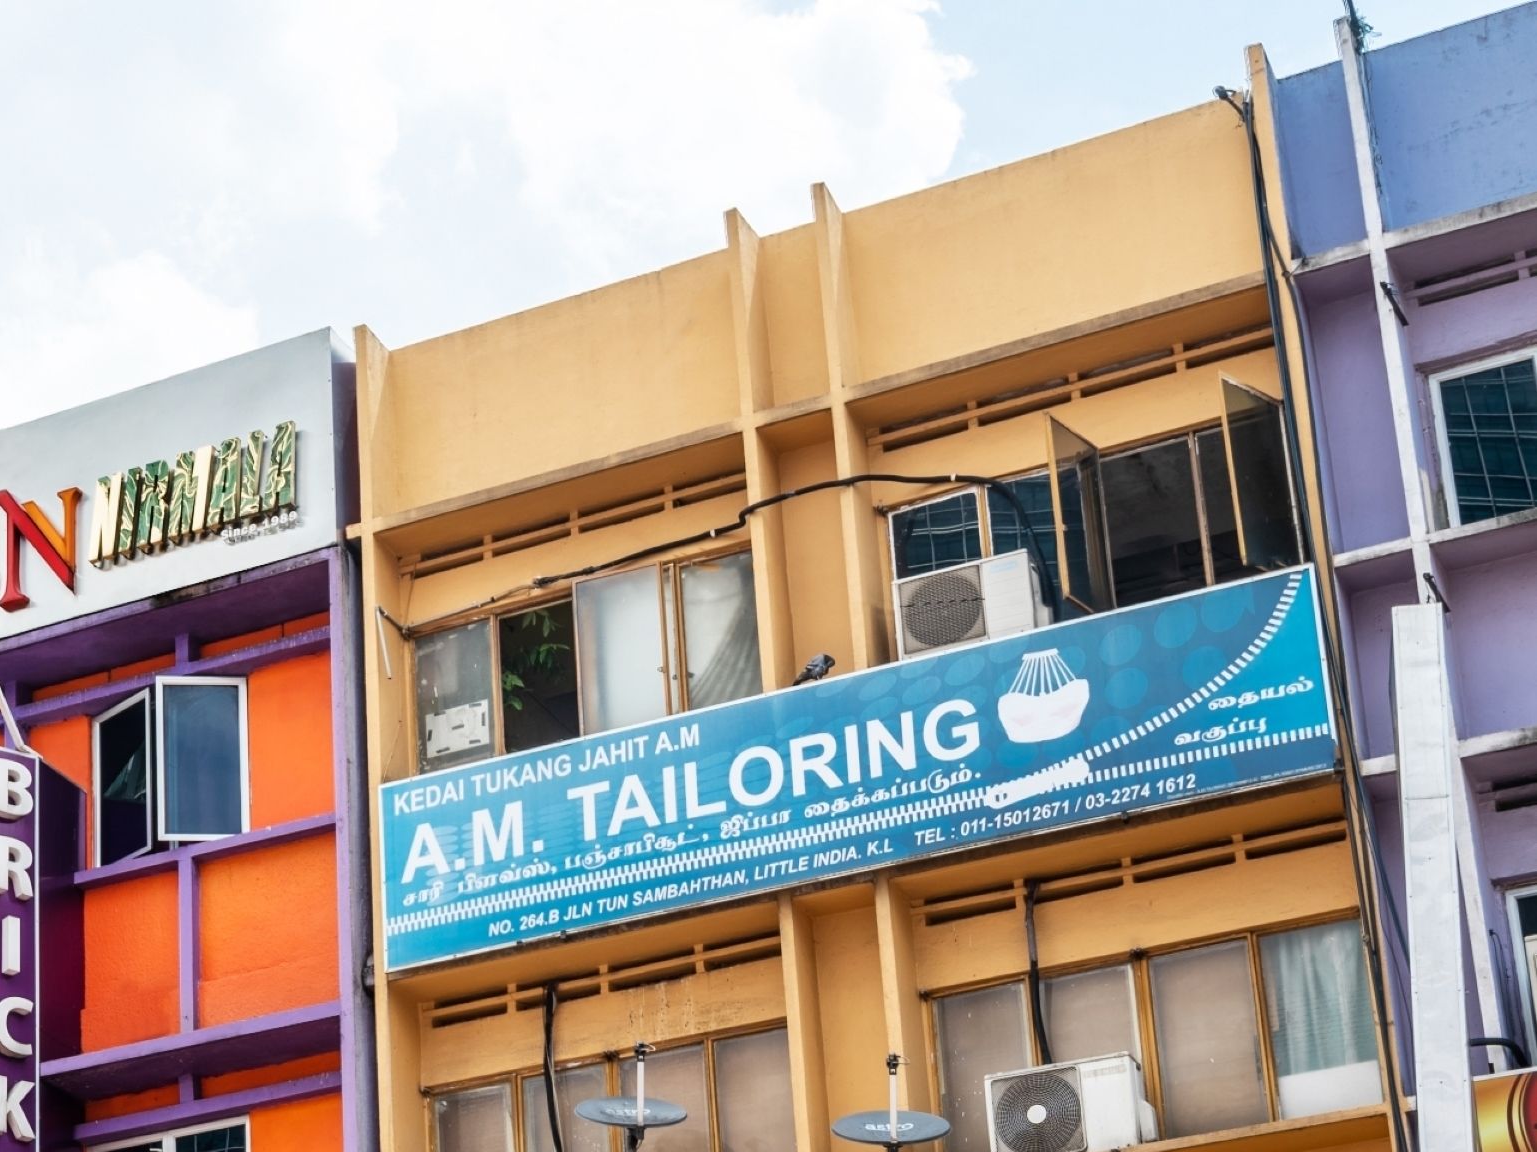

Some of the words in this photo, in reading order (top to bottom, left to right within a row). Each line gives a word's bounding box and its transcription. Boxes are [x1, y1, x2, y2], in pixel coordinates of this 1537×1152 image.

[89, 420, 298, 568] NIRMALA
[220, 523, 258, 539] Since
[262, 510, 298, 528] 1989
[394, 780, 464, 816] KEDAI
[471, 755, 572, 796] TUKANG
[578, 735, 650, 772] JAHIT
[655, 723, 701, 754] A.M
[401, 799, 544, 885] A.M.
[567, 699, 981, 842] TAILORING
[488, 919, 515, 937] NO.
[519, 909, 560, 931] 264.B
[563, 902, 592, 922] JLN
[597, 894, 629, 914] TUN
[754, 855, 810, 881] LITTLE
[914, 826, 946, 846] TEL
[960, 799, 1070, 836] 011-15012671
[1085, 782, 1151, 810] 03-2274
[1156, 773, 1196, 796] 1612
